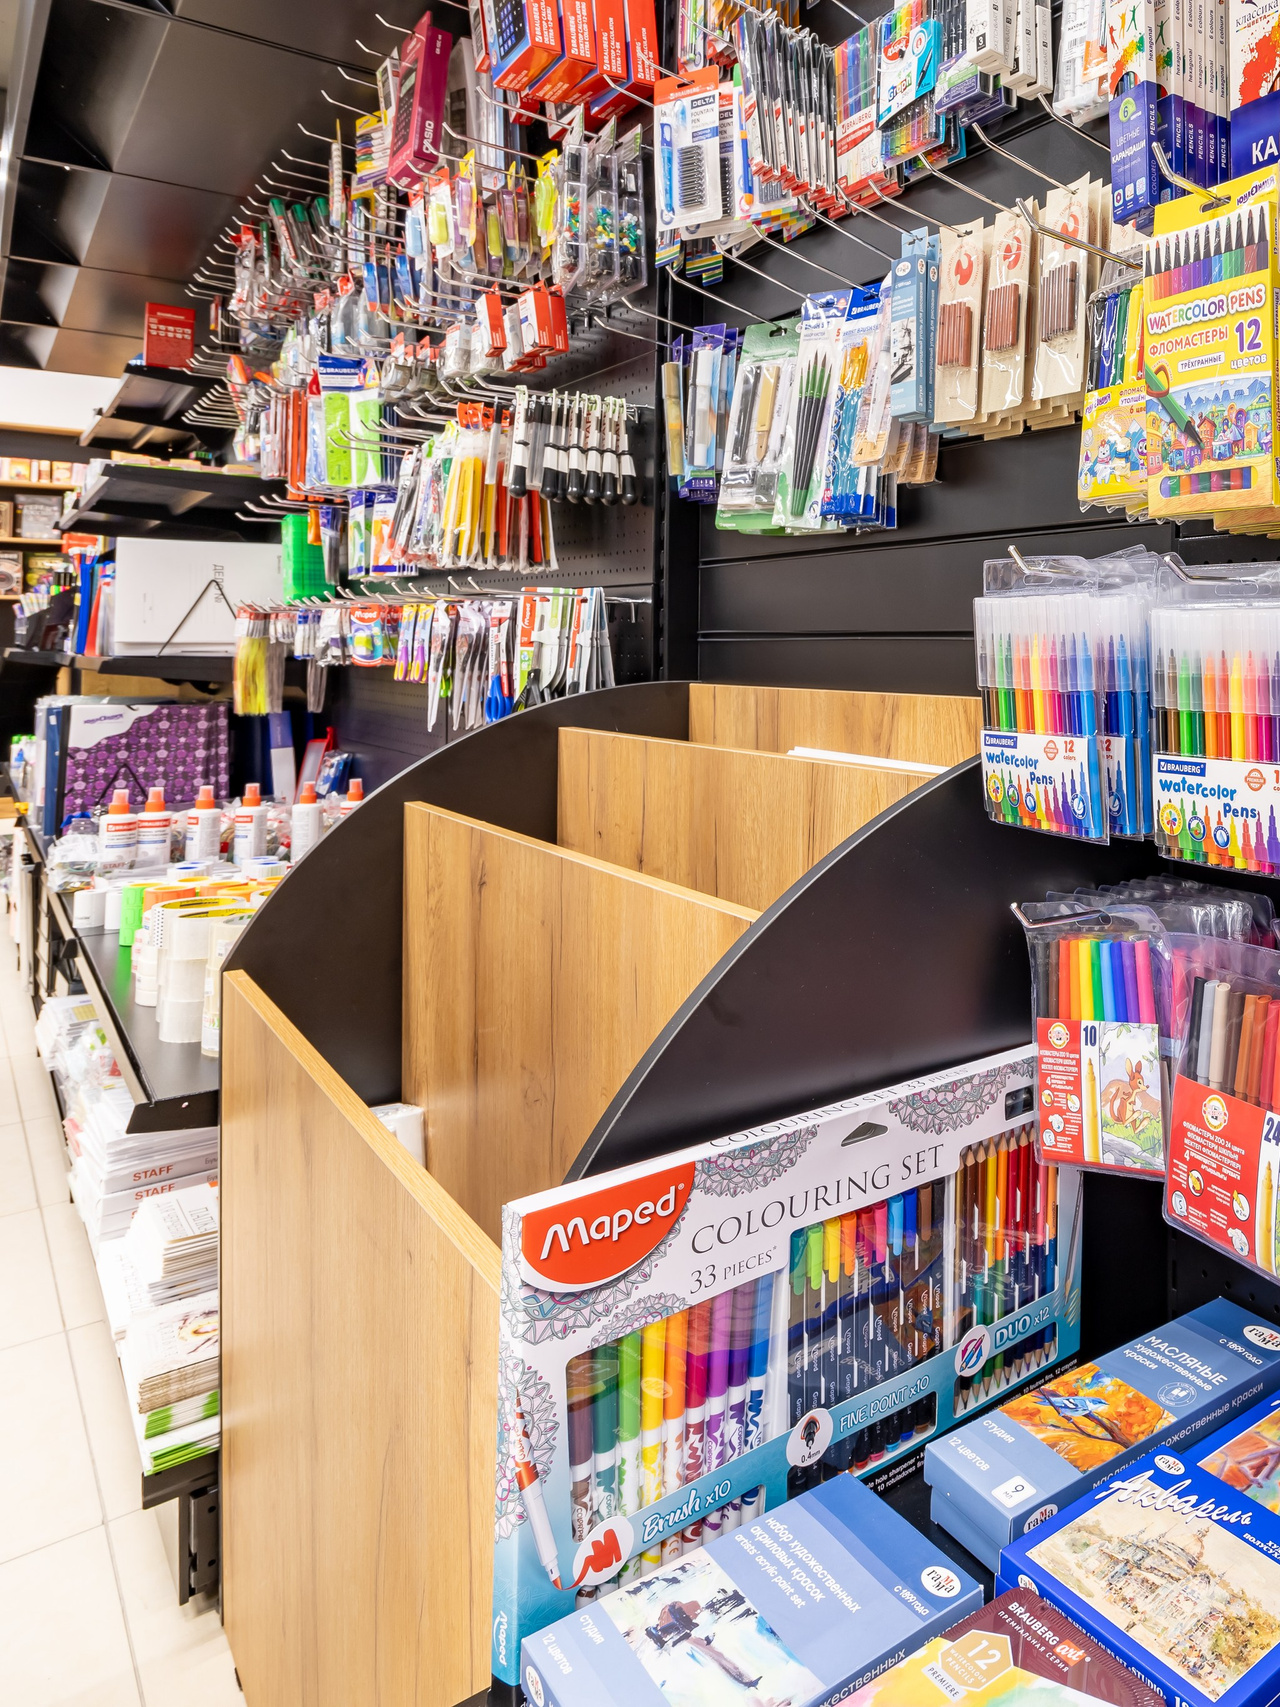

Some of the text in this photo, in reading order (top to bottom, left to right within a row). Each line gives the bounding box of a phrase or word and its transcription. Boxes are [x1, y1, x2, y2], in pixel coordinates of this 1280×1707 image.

[1246, 15, 1268, 28] ЦВЕТА
[691, 108, 714, 117] FOUNTAIN
[692, 97, 714, 106] DELTA
[1124, 106, 1128, 118] 6
[1112, 143, 1146, 164] КАРАНДАШИ
[1116, 130, 1140, 148] ЦВЕТНЫЕ
[1149, 288, 1263, 330] WATERCOLOR PENS
[1149, 327, 1229, 356] ФЛОМАСТЕРЫ
[1235, 319, 1262, 352] 12
[1181, 355, 1221, 370] ТРЁХГРАННЫЕ
[1231, 354, 1267, 369] цветов
[355, 610, 376, 619] Maped
[1167, 764, 1201, 773] BRAUBERG
[1160, 777, 1236, 800] watercolor
[1083, 1025, 1096, 1046] 10
[1183, 1121, 1214, 1140] ФЛОМАСТЕРЫ
[1215, 1135, 1225, 1145] ZOO
[1226, 1140, 1231, 1148] 24
[133, 1165, 173, 1181] STAFF
[135, 1183, 175, 1200] STAFF
[690, 1142, 945, 1256] COLOURING SET
[539, 1186, 678, 1261] Maped
[689, 1262, 718, 1294] 33
[994, 1306, 1051, 1350] DUO x12
[1122, 1348, 1159, 1371] краски
[1134, 1342, 1214, 1392] художественные
[1144, 1336, 1228, 1387] МАСЛЯНЫЕ
[840, 1375, 930, 1432] FINE POINT x10
[1230, 1382, 1264, 1412] краски
[983, 1420, 1015, 1443] студия
[1015, 1484, 1024, 1495] 9
[1095, 1470, 1251, 1525] Акварель
[642, 1480, 731, 1543] Brush x10
[750, 1525, 826, 1602] акриловых красок
[765, 1517, 862, 1614] набор художественных
[755, 1554, 777, 1578] acrylic
[771, 1572, 793, 1598] paint
[791, 1592, 805, 1609] set
[494, 1611, 508, 1666] Maped
[580, 1614, 605, 1645] студия
[998, 1610, 1070, 1673] ПРЕМИАЛЬНАЯ СЕРИЯ
[1008, 1602, 1085, 1663] BRAUBERG art
[949, 1647, 988, 1683] WATERCOLOUR
[967, 1639, 1001, 1670] 12
[927, 1666, 960, 1698] PREMIERE
[945, 1657, 975, 1684] PENCILS
